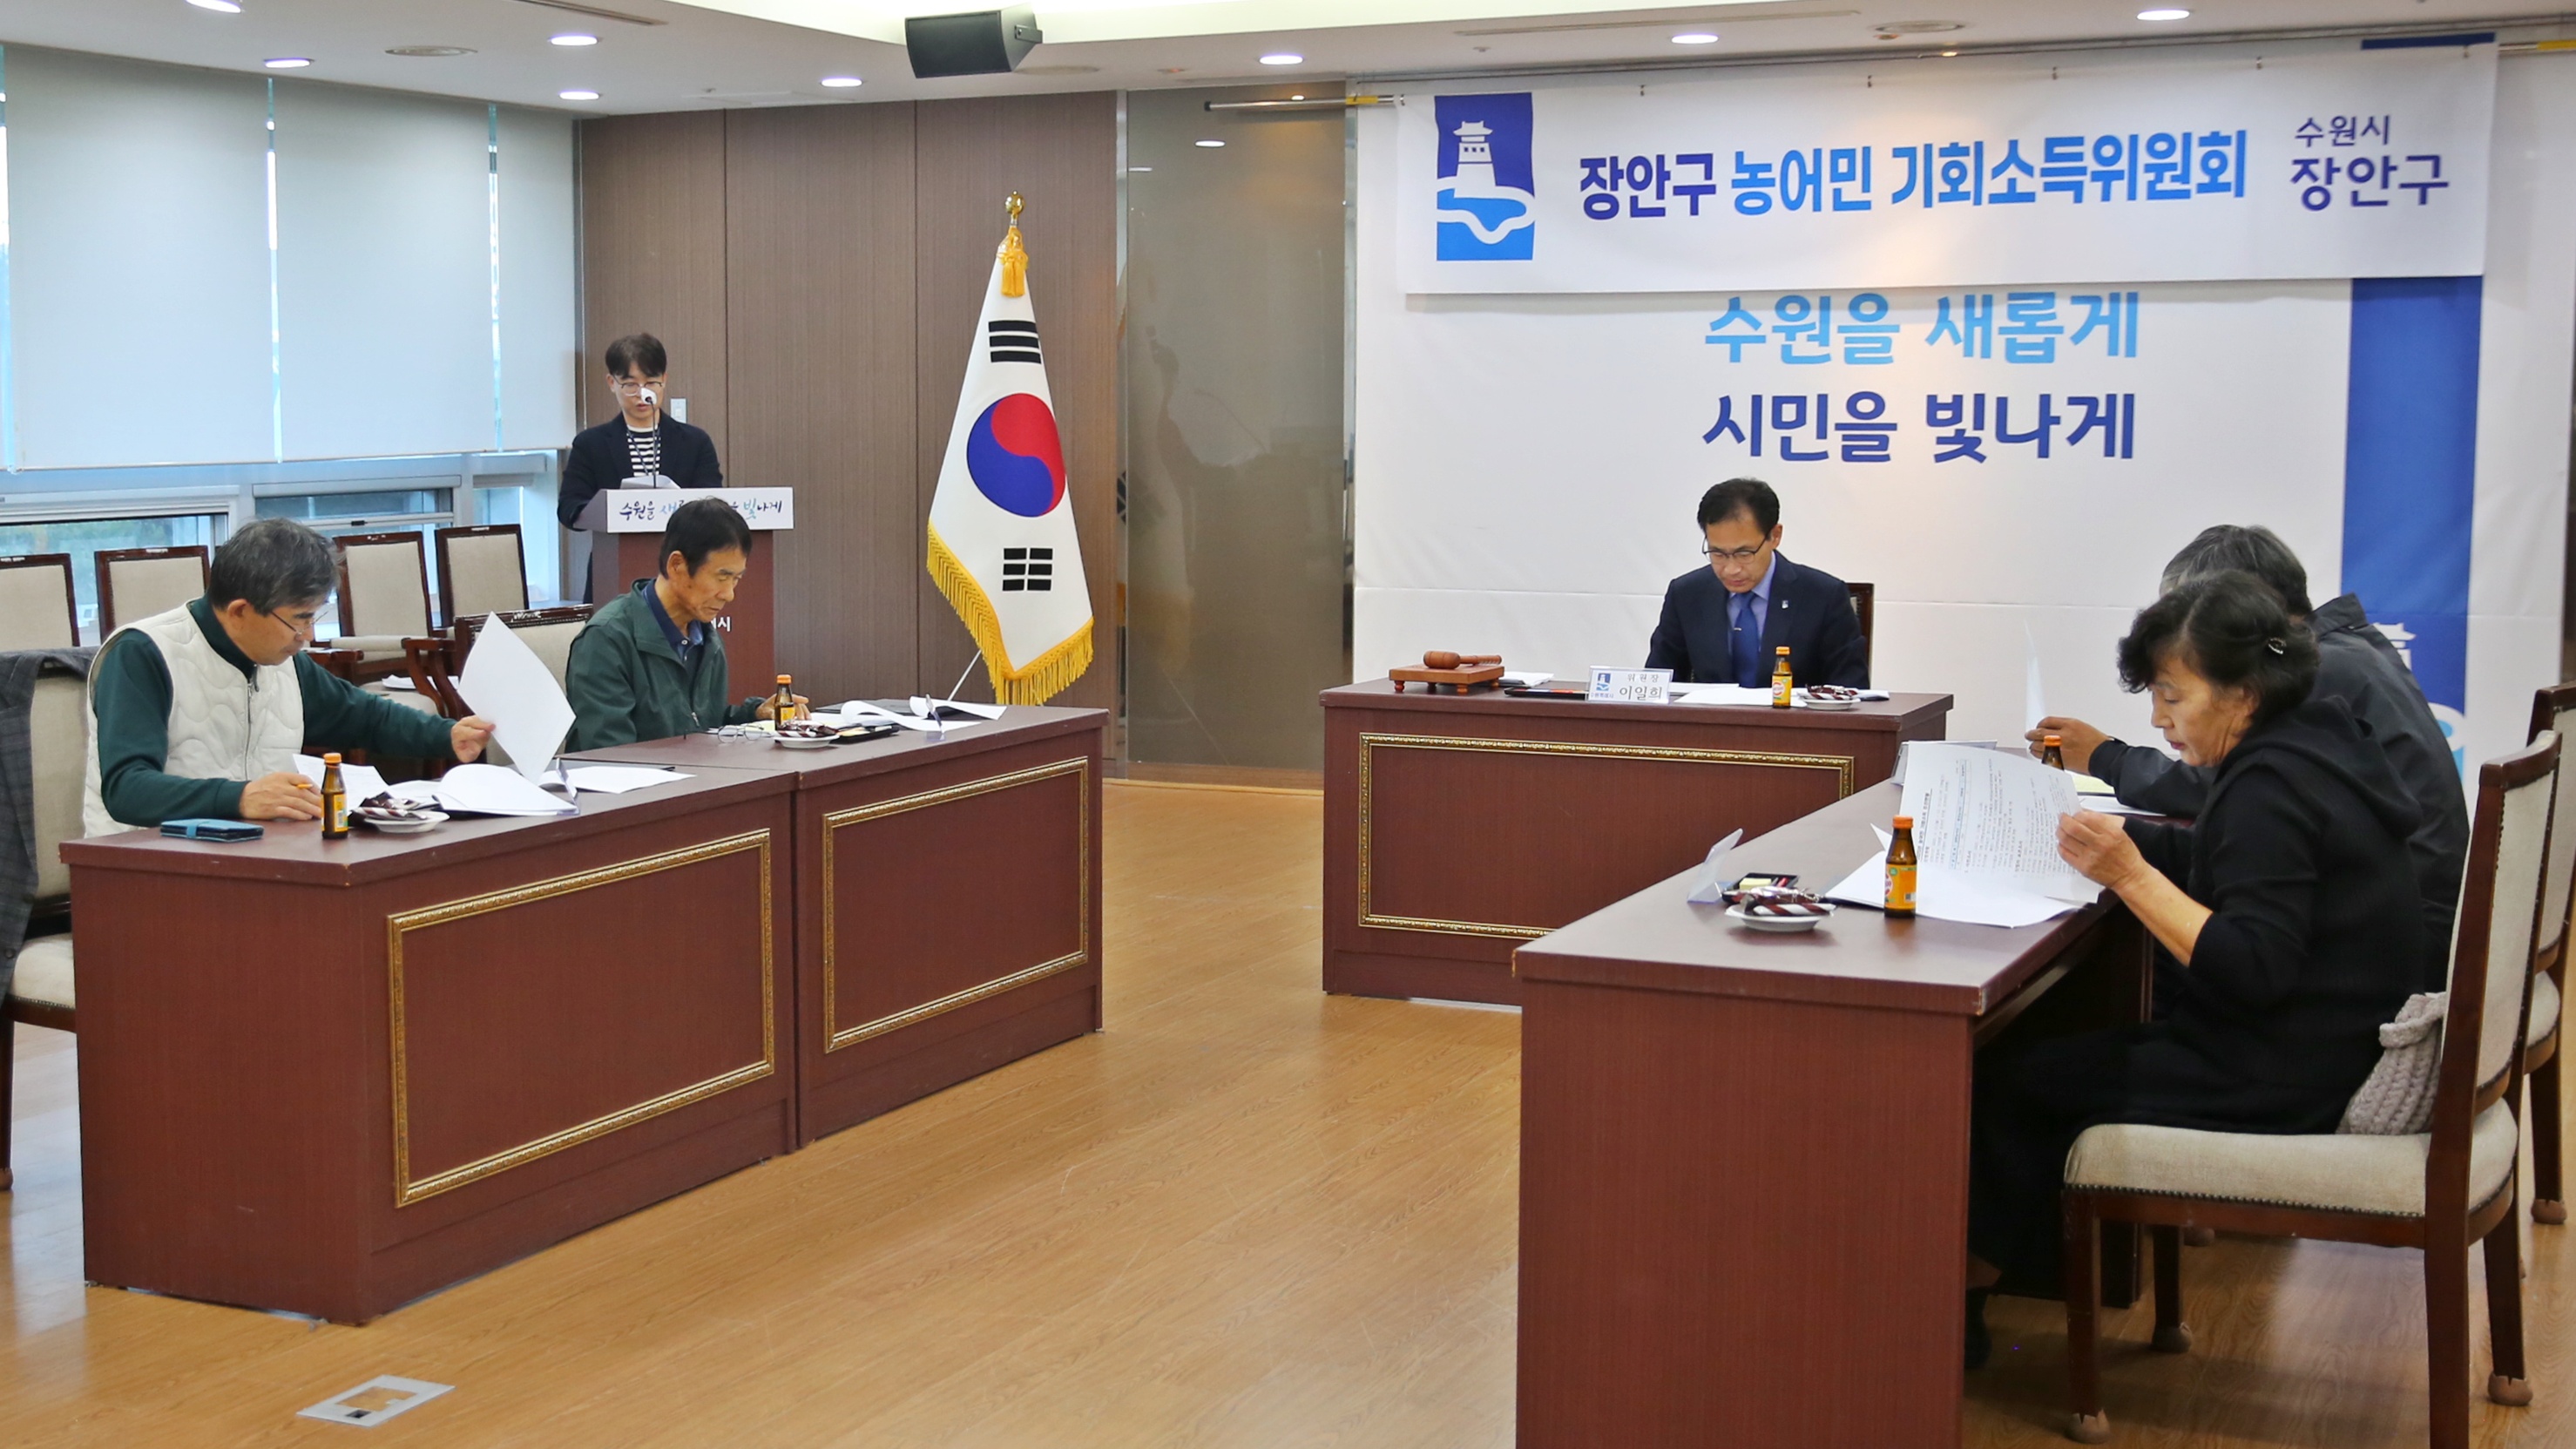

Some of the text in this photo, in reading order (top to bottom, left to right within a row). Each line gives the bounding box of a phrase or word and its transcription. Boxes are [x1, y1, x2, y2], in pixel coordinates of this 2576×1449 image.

[2295, 114, 2392, 150] 수원시
[1579, 128, 2248, 220] 장안구 농어민 기회소득위원회
[2290, 153, 2450, 213] 장안구
[1705, 290, 2140, 366] 수원을 새롭게
[1703, 391, 2135, 464] 시민을 빛나게
[619, 500, 655, 521] 수원을
[743, 498, 782, 520] 빛나게
[1619, 686, 1662, 701] 이일희
